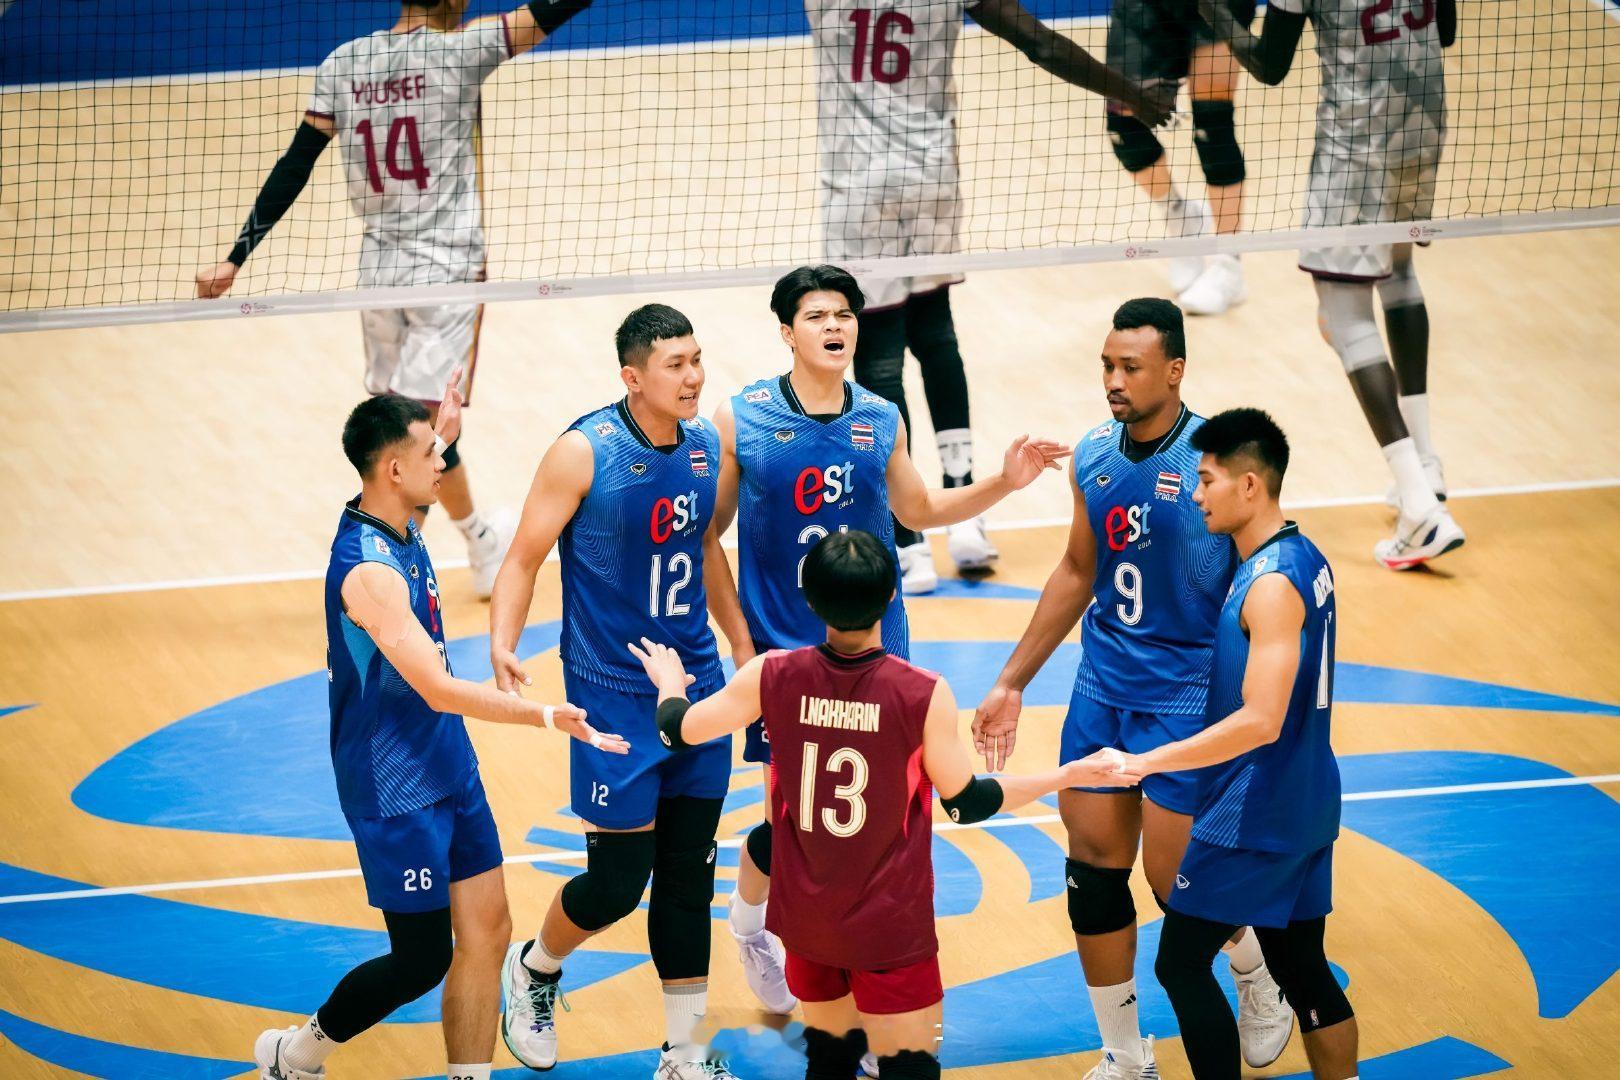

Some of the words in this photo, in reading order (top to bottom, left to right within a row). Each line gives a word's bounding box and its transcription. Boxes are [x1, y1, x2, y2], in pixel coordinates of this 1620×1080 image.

[850, 8, 914, 84] 16
[352, 74, 425, 104] YOUSEF
[355, 116, 430, 193] 14
[793, 461, 855, 516] est
[651, 490, 699, 544] est
[1105, 502, 1152, 552] est
[650, 552, 692, 617] 12
[1113, 562, 1143, 627] 9
[799, 695, 881, 733] I.NAKHARIN
[591, 781, 609, 807] 12
[799, 741, 869, 838] 13
[403, 867, 433, 893] 26
